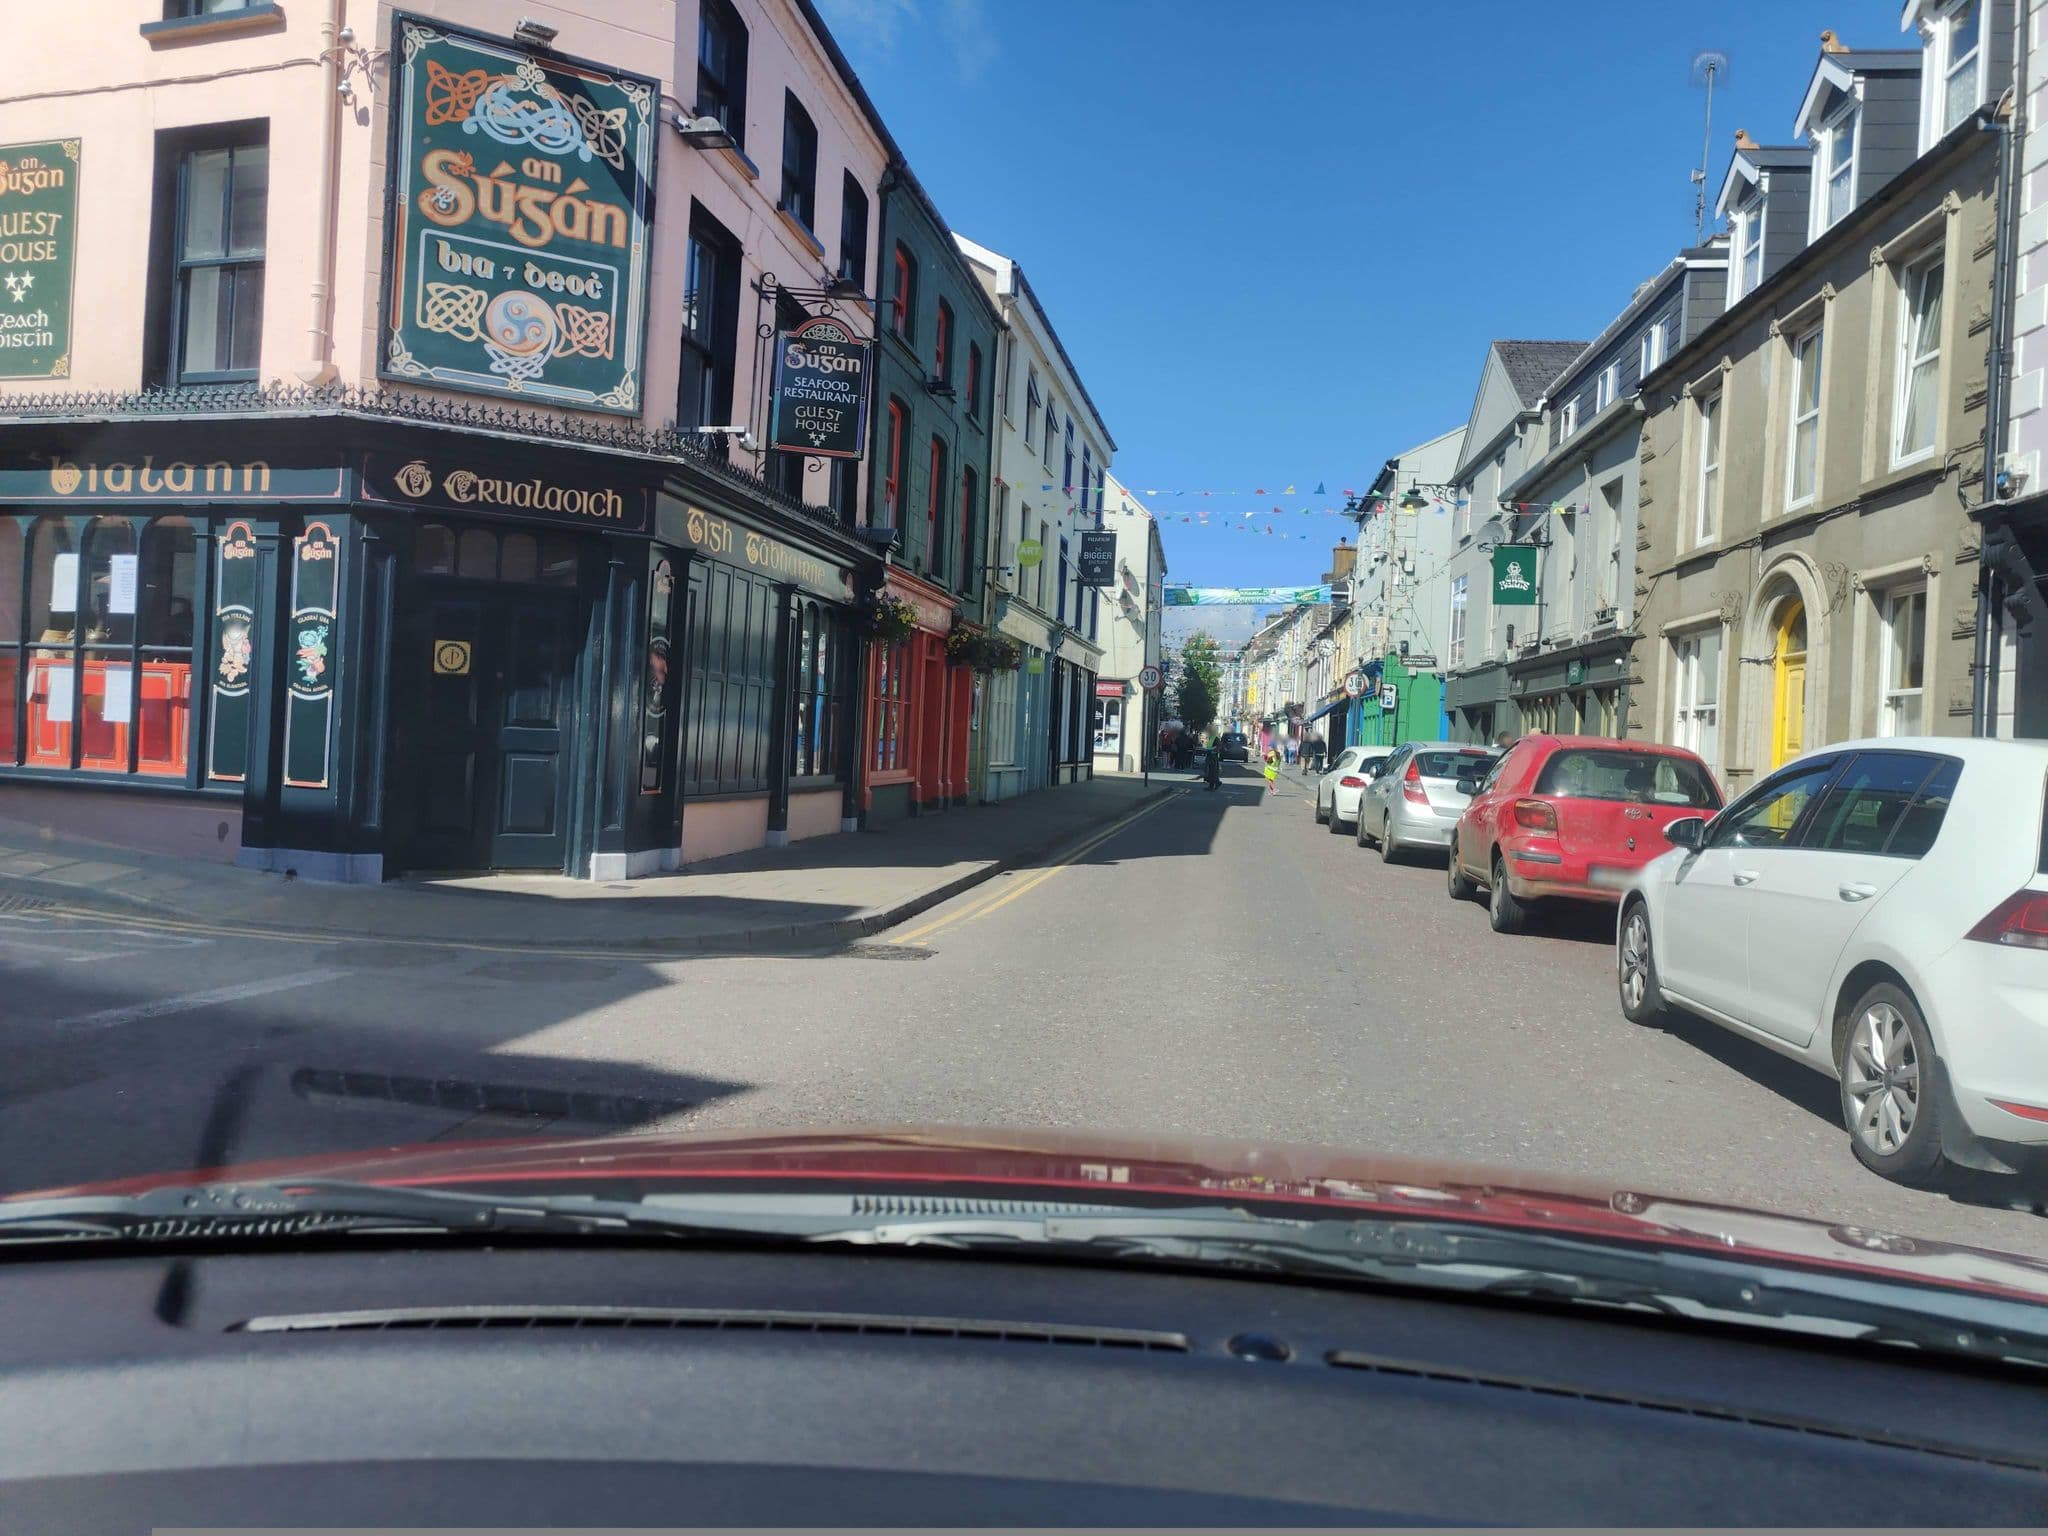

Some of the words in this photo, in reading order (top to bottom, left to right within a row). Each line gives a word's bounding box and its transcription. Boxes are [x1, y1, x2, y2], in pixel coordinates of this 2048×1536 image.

[21, 156, 38, 169] an
[522, 157, 562, 184] an
[417, 149, 628, 248] Súgán
[0, 211, 62, 237] UEST
[0, 241, 57, 263] OUSE
[785, 342, 861, 374] Súgán
[819, 345, 837, 356] an
[794, 377, 850, 392] SEAFOOD
[784, 387, 858, 404] RESTAURANT
[795, 405, 843, 422] GUEST
[795, 419, 841, 433] HOUSE
[1083, 551, 1113, 560] BIGGER
[1144, 671, 1157, 682] 30
